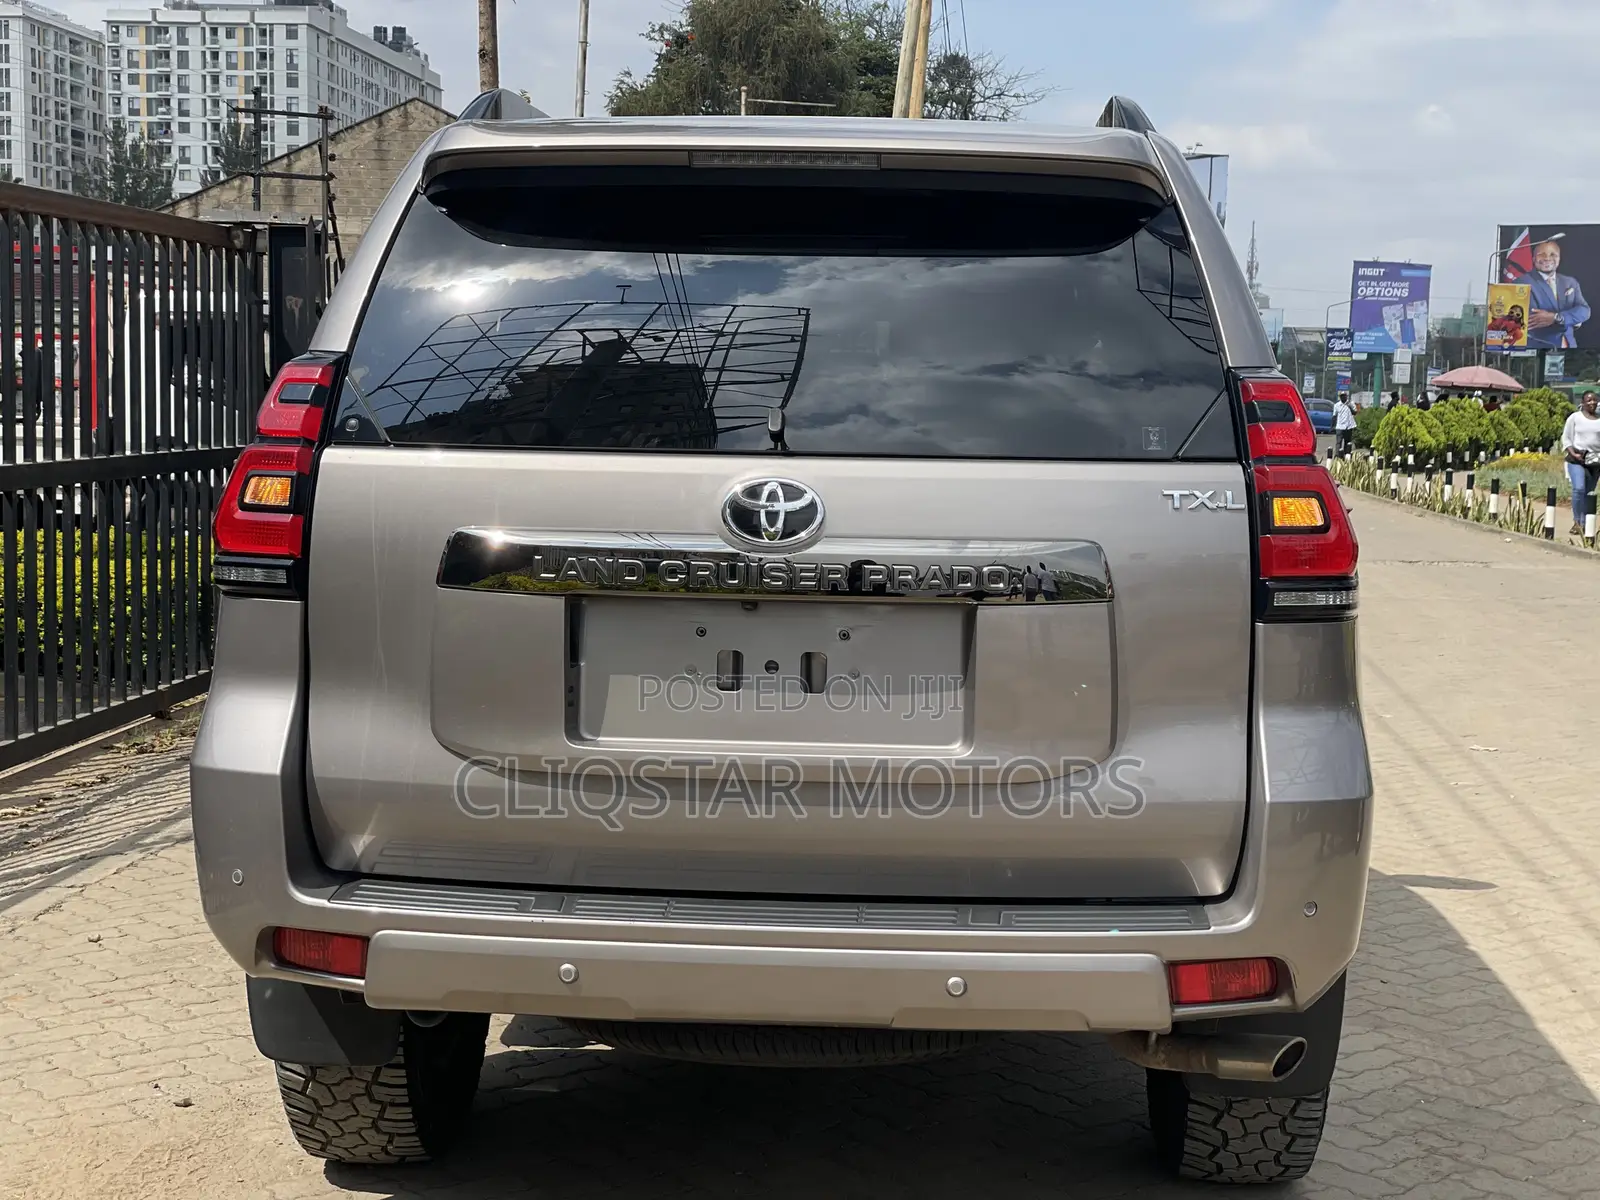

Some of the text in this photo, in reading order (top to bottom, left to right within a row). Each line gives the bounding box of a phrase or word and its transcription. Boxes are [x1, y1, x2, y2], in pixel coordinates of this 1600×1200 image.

[1357, 287, 1409, 297] OPTIONS
[533, 555, 1012, 593] LAND CRUISER PRADO
